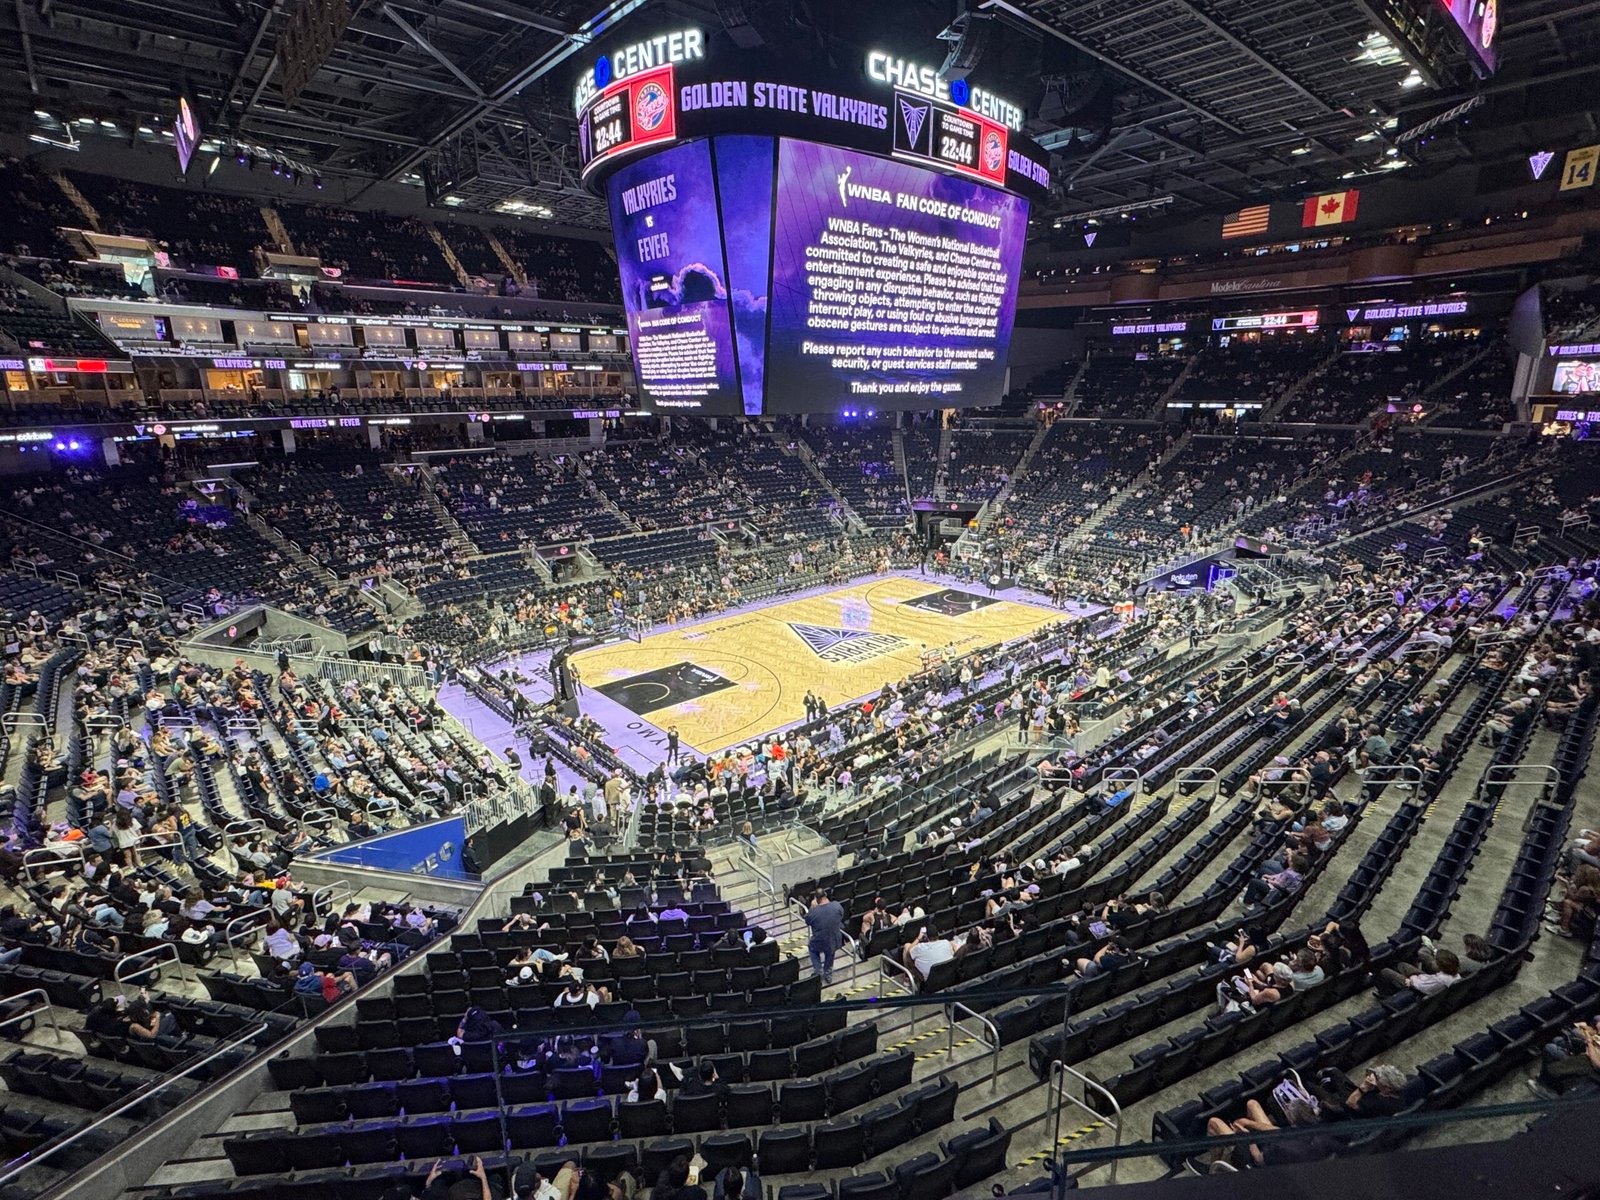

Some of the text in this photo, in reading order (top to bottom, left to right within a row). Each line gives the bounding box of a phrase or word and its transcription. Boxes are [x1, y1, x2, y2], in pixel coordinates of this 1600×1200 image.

[613, 29, 704, 79] CENTER
[868, 52, 1022, 132] CHASE CENTER
[680, 83, 888, 129] GOLDEN STATE VALKYRIES
[943, 114, 974, 130] COUNTDOWN
[595, 120, 622, 152] 22:44
[941, 137, 973, 164] 22:44
[1008, 149, 1032, 177] GOLDEN
[1567, 162, 1590, 185] 14
[622, 174, 677, 215] VALKYRIES
[848, 183, 1001, 229] WNBA FAN CODE OF CONDUCT
[638, 232, 670, 262] FEVER
[821, 231, 1001, 270] Association, The Valkyries, and Chase Center are
[828, 217, 859, 234] WNBA
[862, 223, 882, 238] Fans
[890, 228, 905, 241] The
[907, 231, 941, 247] Women's
[942, 237, 969, 253] National
[970, 243, 1000, 259] Basketball
[805, 261, 1005, 294] entertainment experience. Please be advised that fans
[806, 246, 1007, 283] committed to creating a safe and enjoyable sports and
[808, 275, 854, 291] engaging
[855, 278, 864, 290] in
[865, 281, 881, 294] any
[882, 282, 922, 297] disruptive
[923, 286, 954, 301] behavior,
[954, 291, 970, 301] such
[970, 294, 978, 302] as
[1211, 279, 1281, 293] Modelo Cantina
[809, 301, 998, 328] interrupt play, or using foul or abusive language and
[813, 288, 998, 316] throwing objects, attempting to enter the court or
[1364, 302, 1467, 319] GOLDEN STATE VALKYRIES
[807, 316, 996, 338] obscene gestures are subject to ejection and arrest.
[1113, 322, 1186, 334] GOLDEN STATE VALKYRIES
[1264, 316, 1287, 325] 22:44
[213, 359, 253, 368] VALKYRIES
[265, 360, 286, 369] FEVER
[802, 341, 995, 360] Please report any such behavior to the nearest usher,
[832, 357, 978, 371] security, or guest services staff member.
[517, 363, 545, 371] VALKYRIES
[553, 363, 567, 371] FEVER
[851, 381, 962, 395] Thank you and enjoy the game.
[290, 419, 327, 428] VALKYRIES
[340, 418, 360, 427] FEVER
[1170, 573, 1198, 582] Rakuten
[819, 634, 908, 663] VALKYRIES
